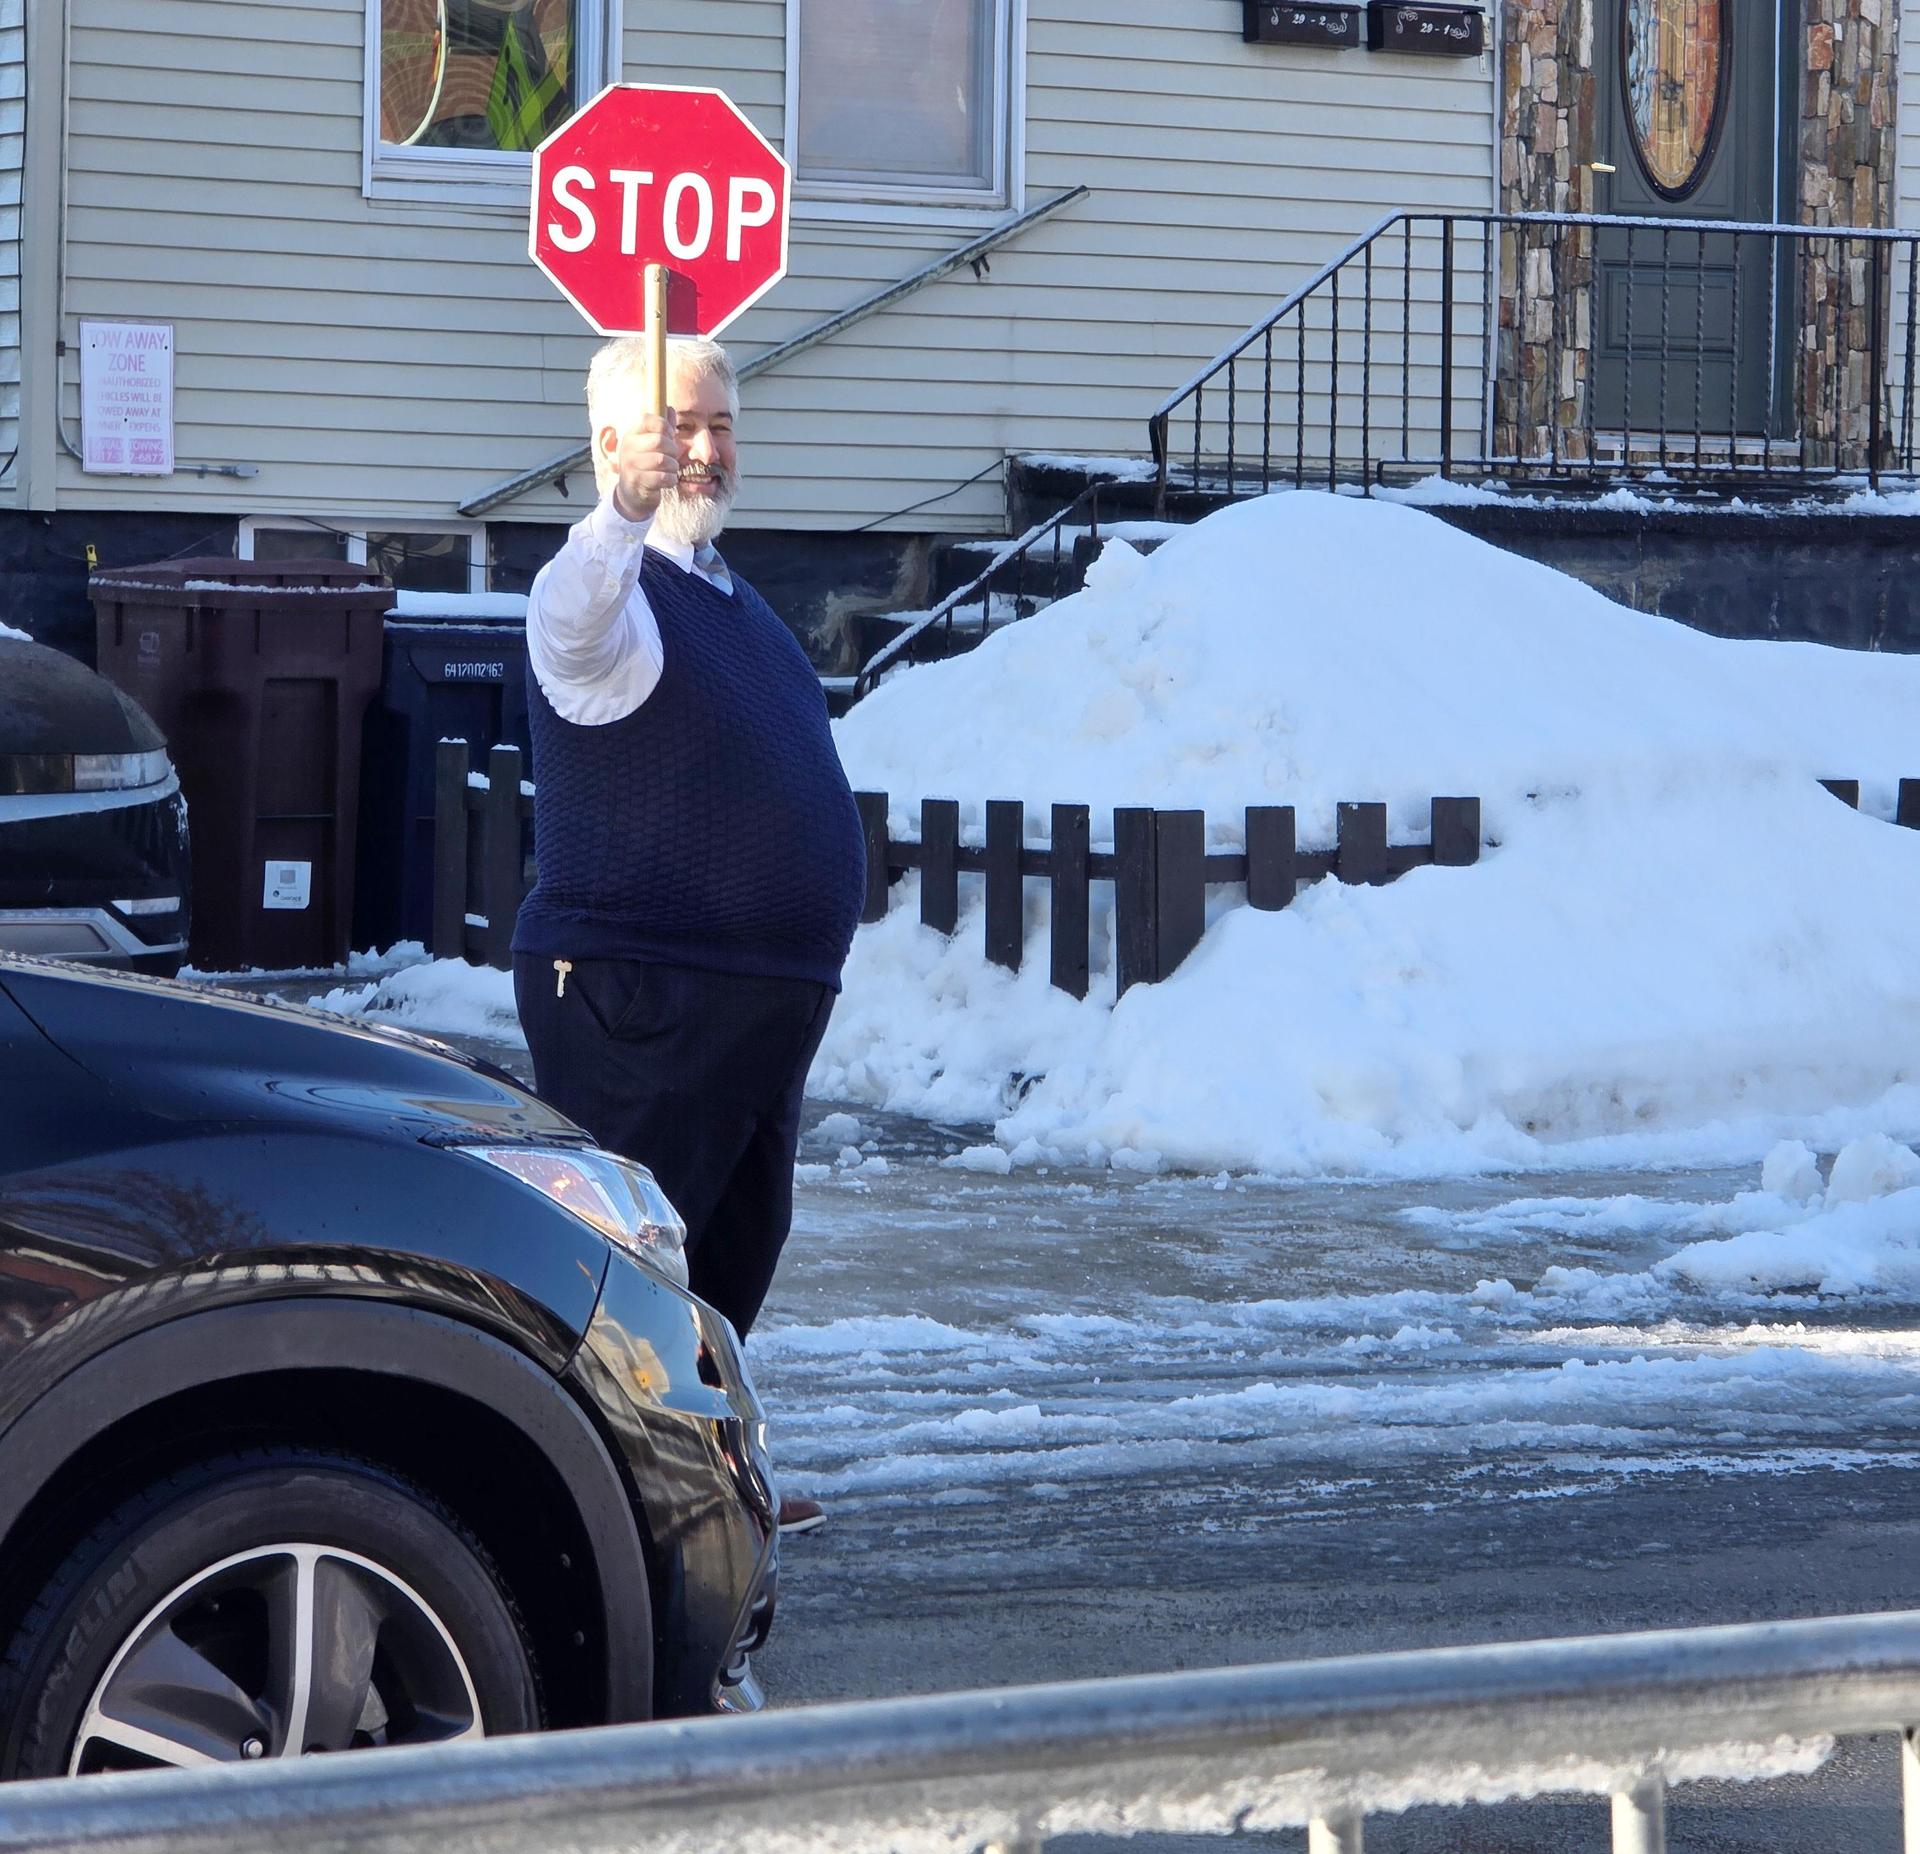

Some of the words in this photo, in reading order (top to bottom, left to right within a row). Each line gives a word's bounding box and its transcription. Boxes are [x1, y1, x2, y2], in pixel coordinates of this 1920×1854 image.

[547, 165, 776, 262] STOP
[124, 331, 166, 350] AWAY
[108, 352, 146, 372] ZONE
